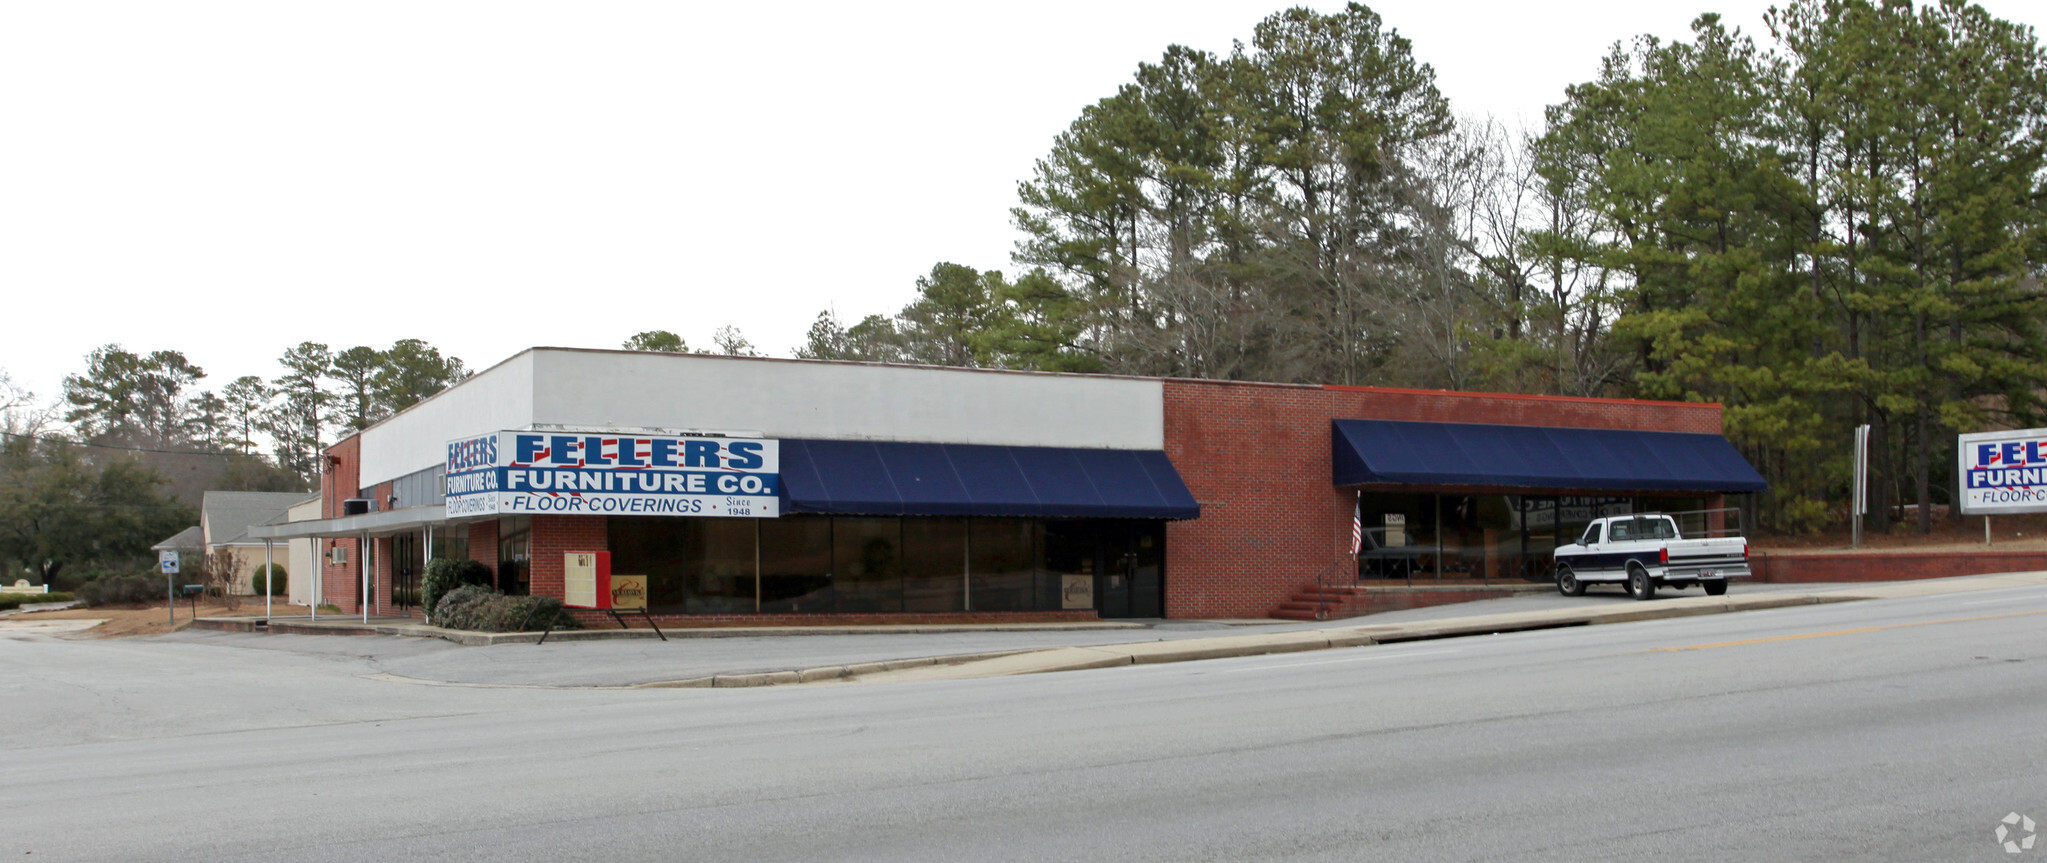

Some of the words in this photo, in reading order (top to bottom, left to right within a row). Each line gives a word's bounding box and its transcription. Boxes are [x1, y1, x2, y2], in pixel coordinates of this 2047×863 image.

[448, 435, 497, 470] FELLERS
[516, 435, 763, 469] FELLERS
[447, 472, 485, 494] FURNITURE
[485, 470, 498, 490] CO.
[507, 470, 706, 492] FURNITURE
[717, 475, 771, 494] CO.
[513, 496, 582, 511] FLOOR
[589, 498, 702, 513] COVERINGS
[726, 496, 751, 507] Since
[1982, 490, 2031, 503] FLOOR
